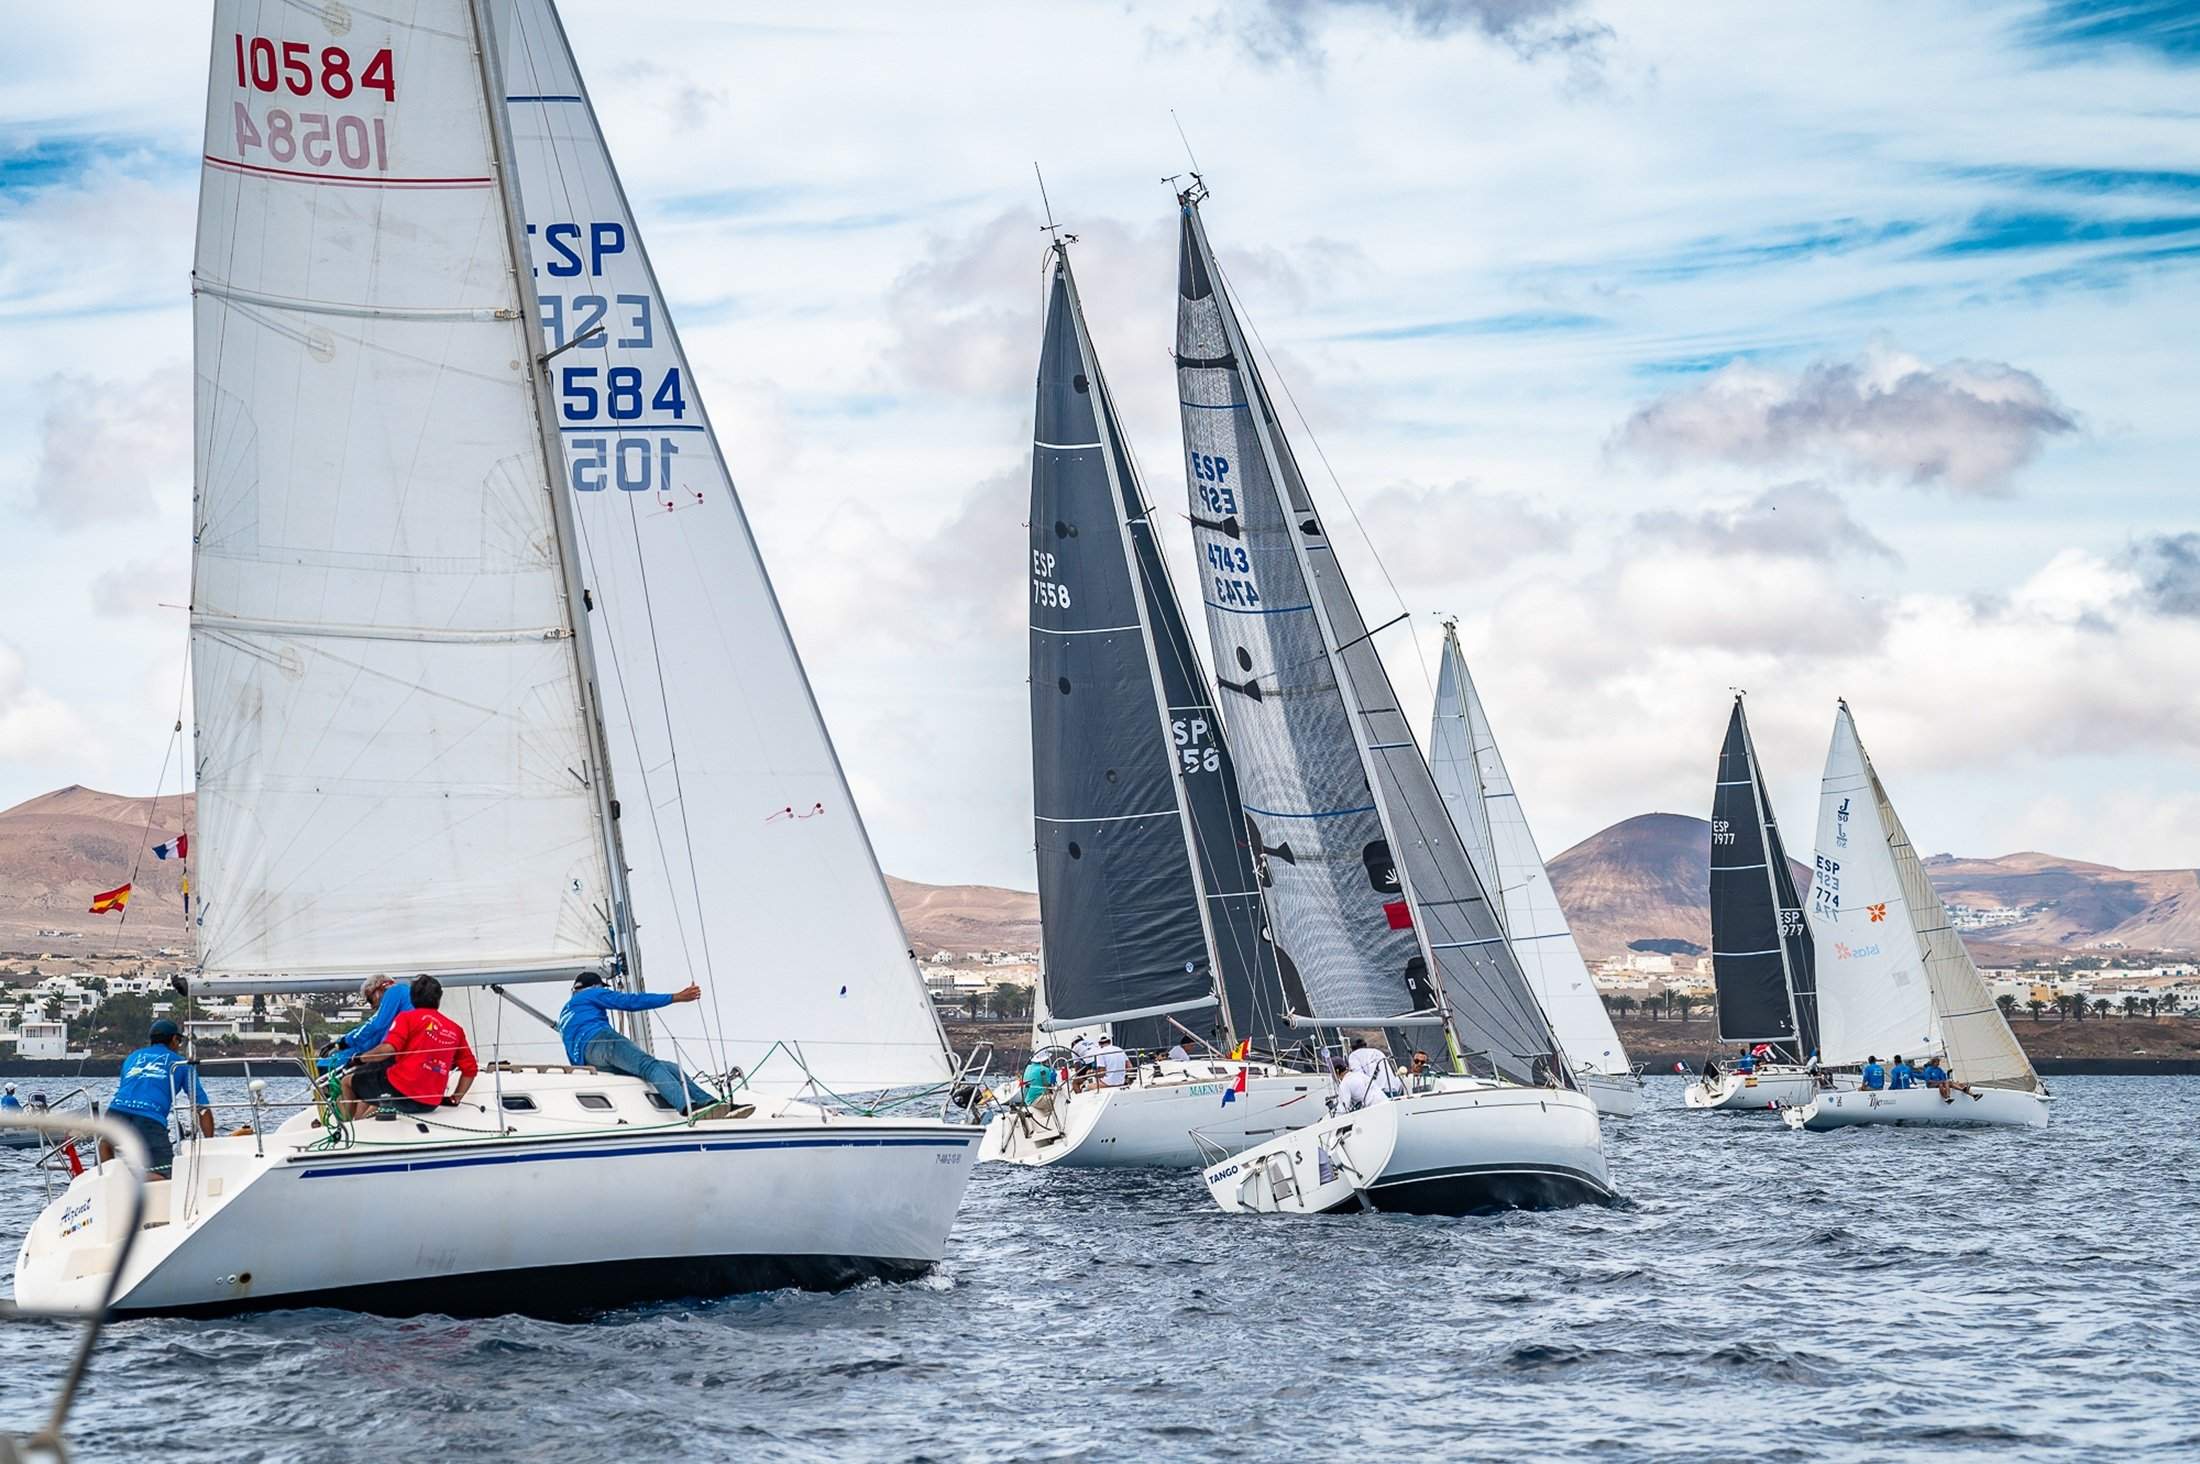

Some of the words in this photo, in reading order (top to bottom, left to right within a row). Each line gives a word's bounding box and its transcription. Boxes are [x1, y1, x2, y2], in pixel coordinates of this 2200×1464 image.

[234, 33, 396, 103] 10584
[526, 222, 626, 277] SP
[551, 366, 686, 420] 584
[1191, 451, 1229, 483] ESP
[1033, 549, 1055, 577] ESP
[1208, 543, 1250, 573] 4743
[1033, 579, 1071, 609] 7558
[1173, 719, 1208, 746] SP
[1177, 747, 1220, 774] 58
[1713, 820, 1729, 833] ESP
[1713, 833, 1735, 845] 7977
[1816, 855, 1840, 875] ESP
[1816, 886, 1839, 908] 774
[1208, 1165, 1239, 1185] TANGO
